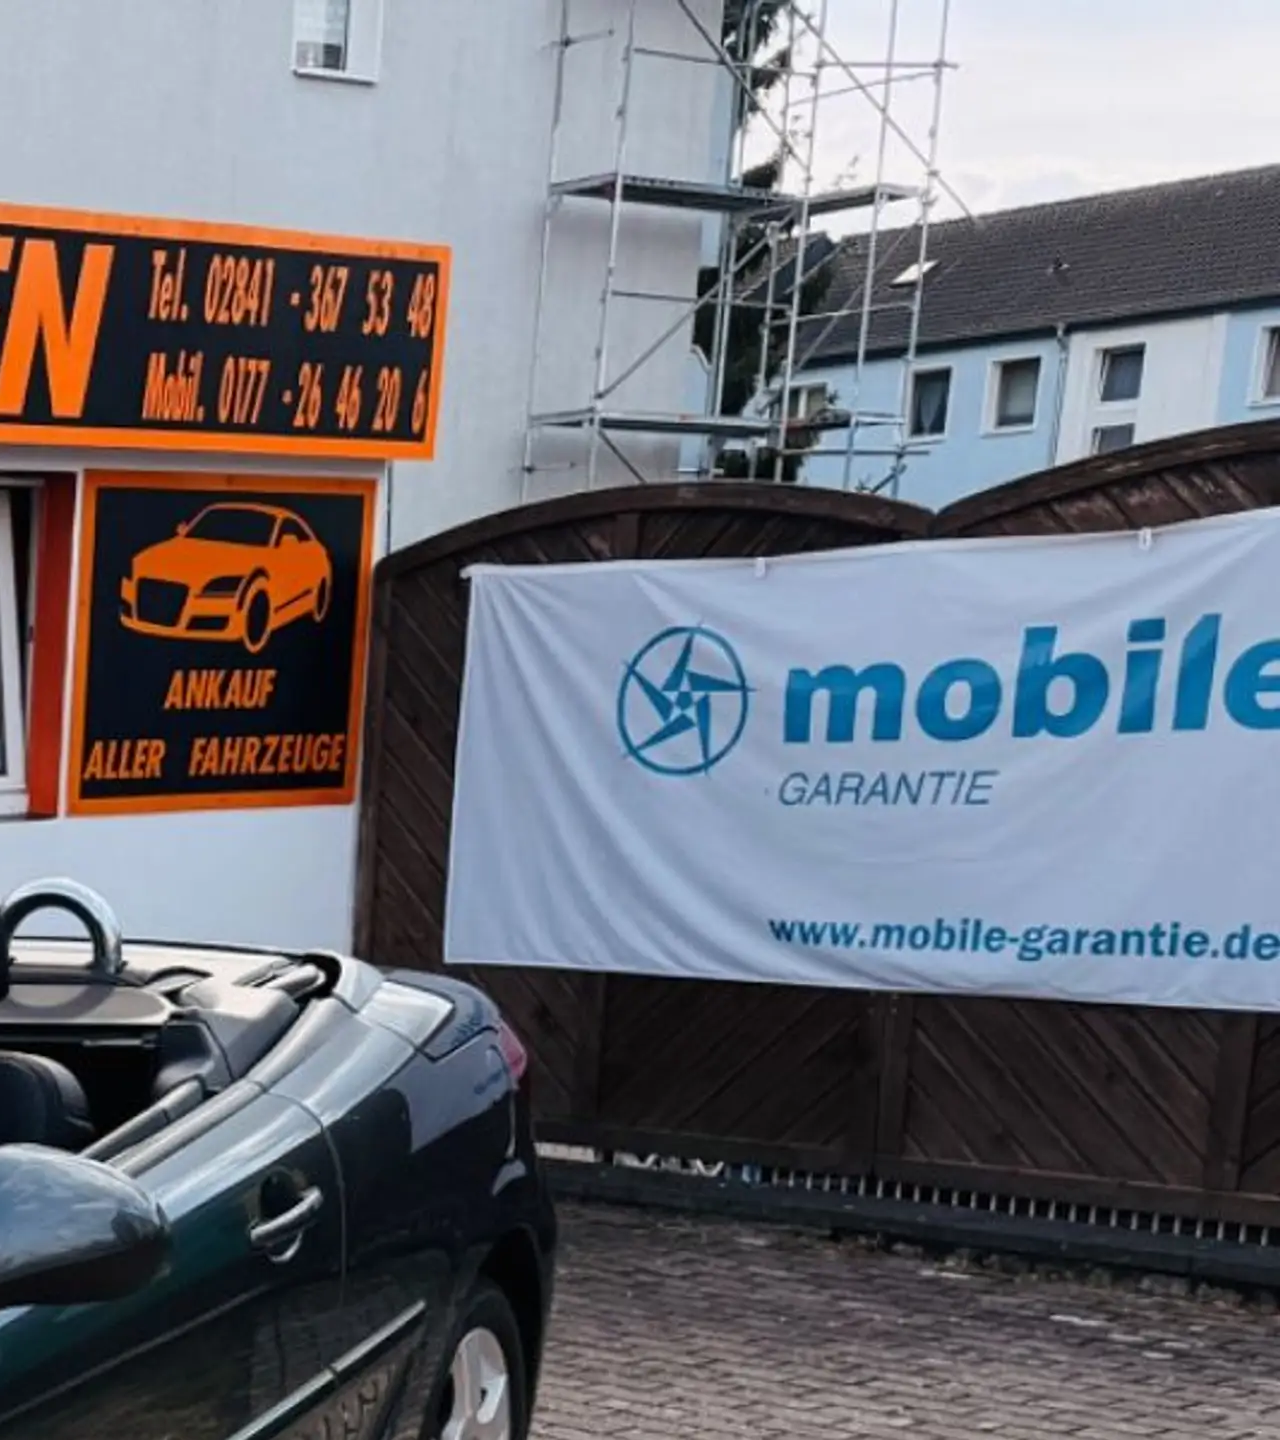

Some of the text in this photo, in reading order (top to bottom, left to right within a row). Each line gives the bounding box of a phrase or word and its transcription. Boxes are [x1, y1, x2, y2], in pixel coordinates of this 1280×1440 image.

[148, 247, 187, 323] Tel.
[203, 253, 275, 328] 02841
[362, 270, 395, 337] 53
[406, 272, 436, 339] 48
[142, 350, 204, 423] Mobil.
[218, 356, 270, 425] 0177
[335, 364, 364, 431] 46
[370, 367, 401, 433] 20
[410, 369, 429, 434] 6
[163, 669, 278, 710] ANKAUF
[782, 612, 1279, 744] mobile
[83, 734, 346, 781] ALLER FAHRZEUGE
[777, 769, 1000, 807] GARANTIE
[769, 915, 1279, 962] www.mobile-garantie.de
